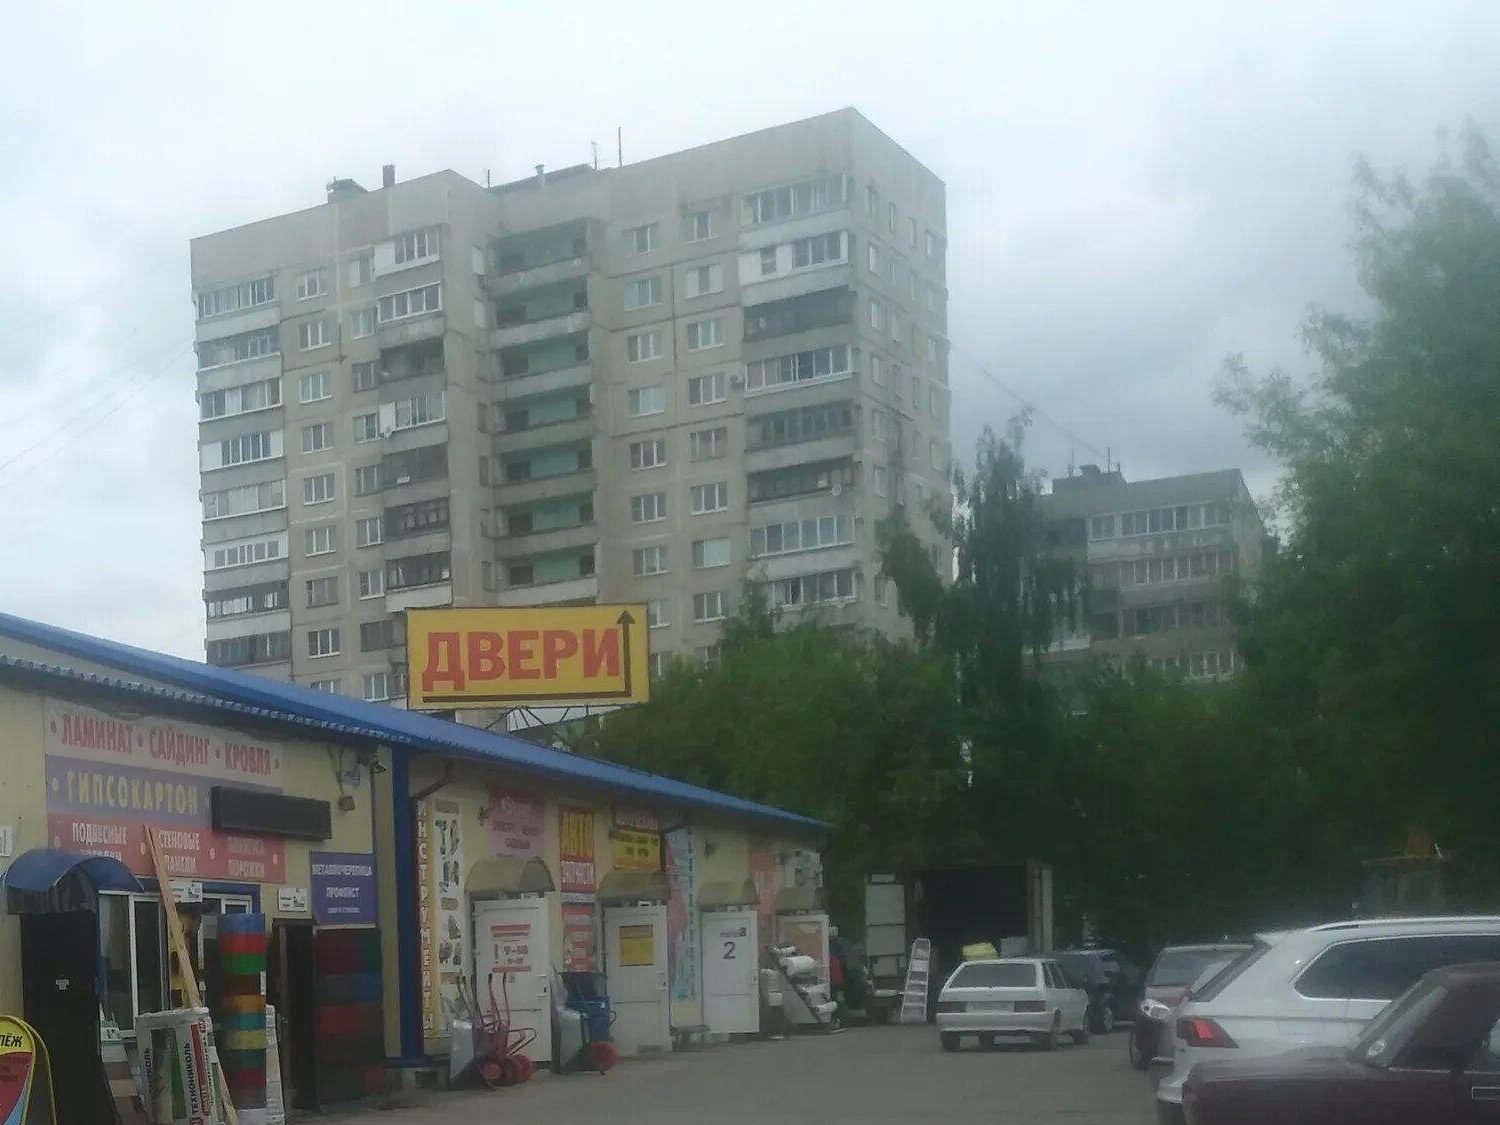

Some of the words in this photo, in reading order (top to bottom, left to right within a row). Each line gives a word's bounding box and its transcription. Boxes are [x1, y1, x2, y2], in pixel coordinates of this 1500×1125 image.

[421, 628, 620, 692] ДВЕРИ
[62, 713, 134, 755] ЛАМИНАТ
[149, 725, 210, 766] САЙДИНГ
[225, 742, 271, 775] КРОВЛЯ
[66, 771, 199, 815] ГИПСОКАРТОН
[72, 822, 128, 847] ПОДВЕСНЫЕ
[158, 830, 200, 851] СТЕНОВЫЕ
[723, 941, 736, 960] 2
[183, 1042, 199, 1115] ТЕХНОНИКОЛЬ
